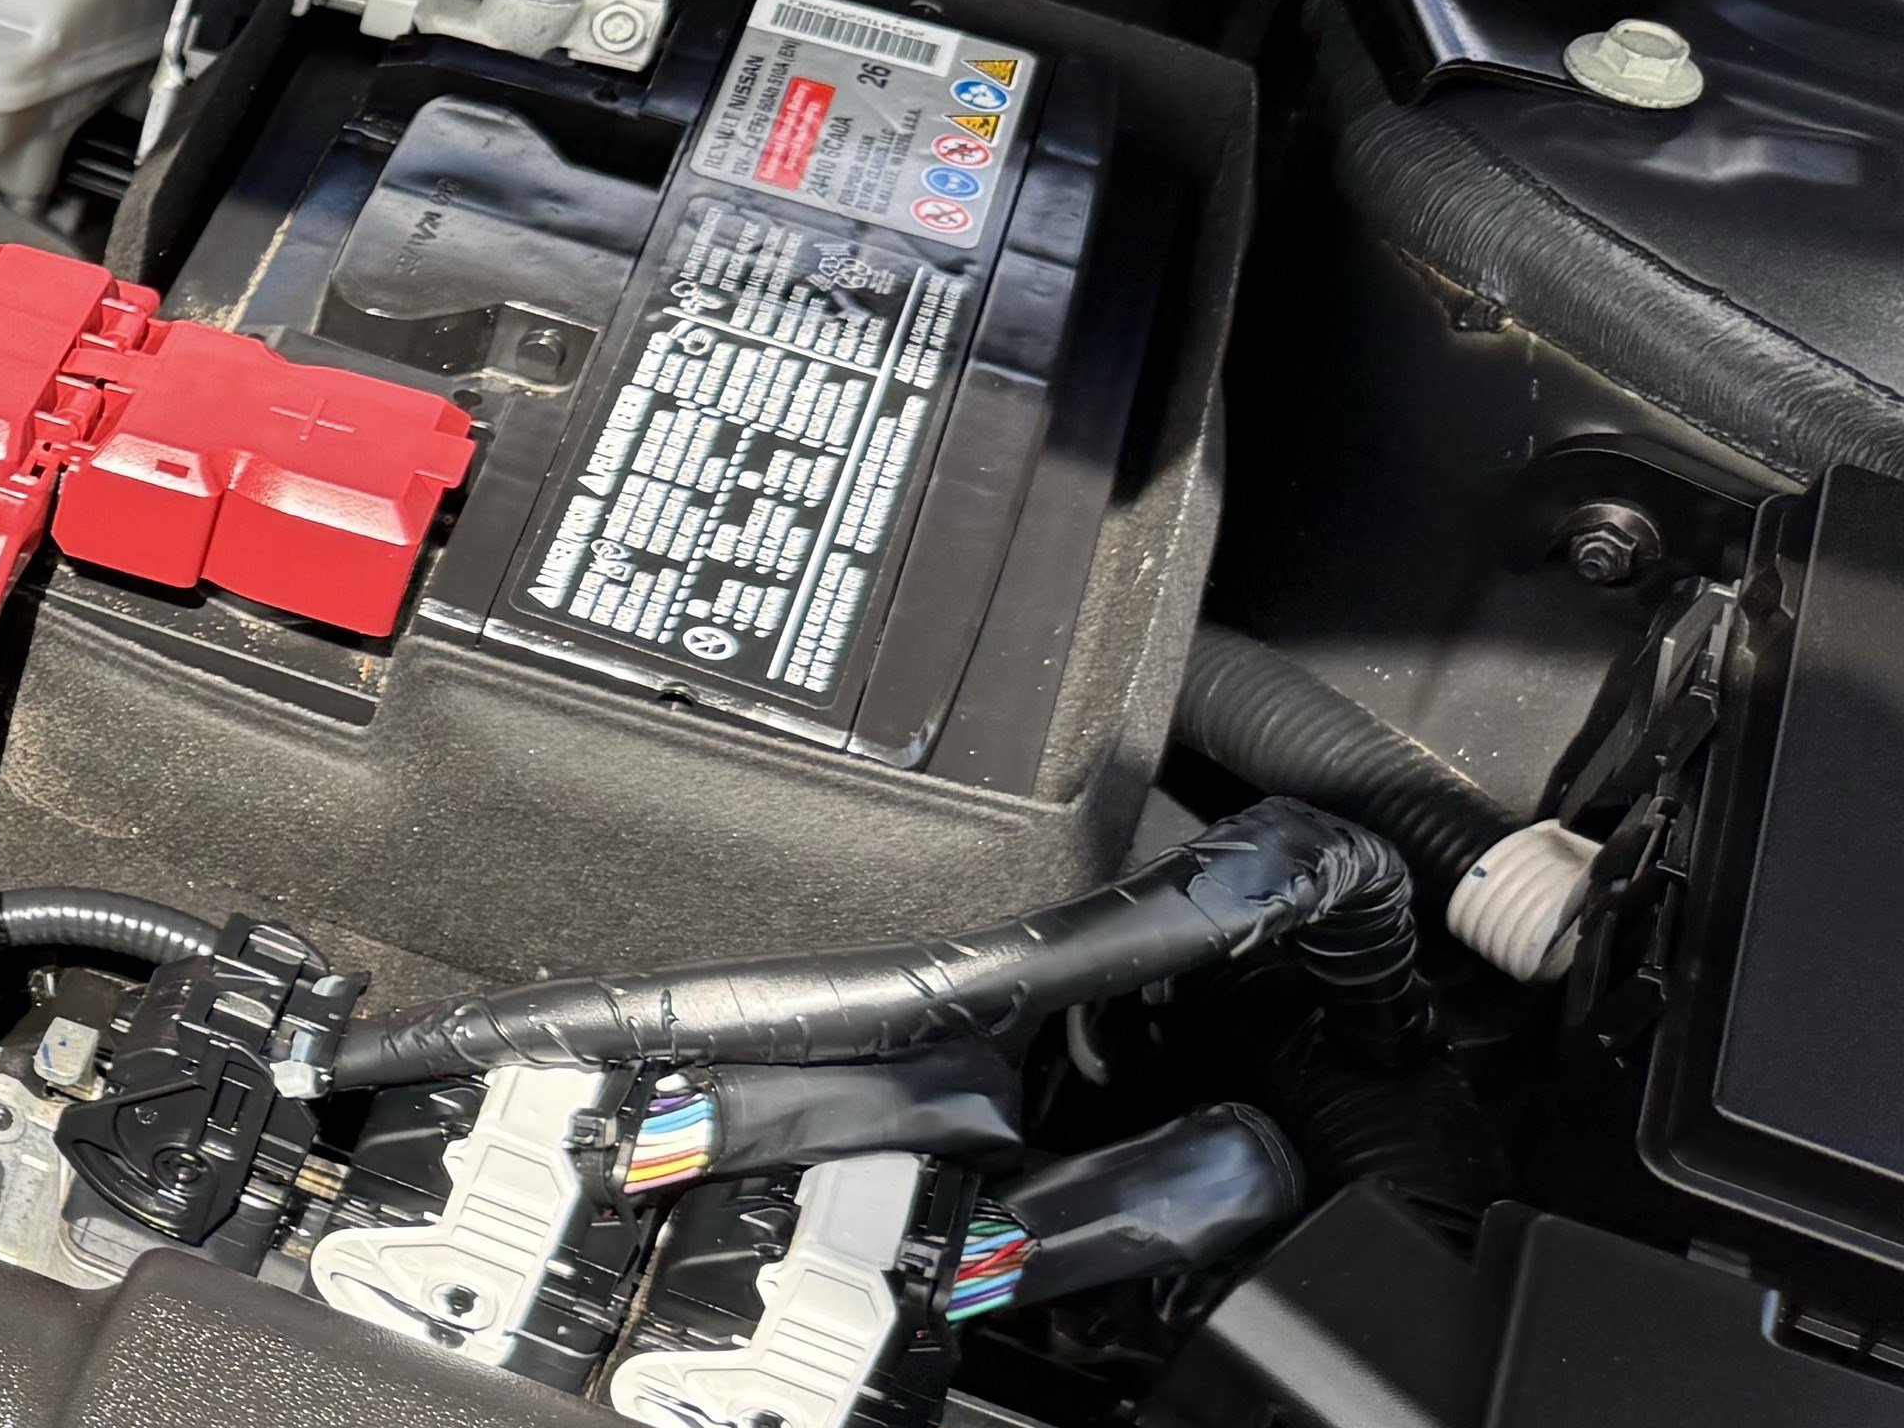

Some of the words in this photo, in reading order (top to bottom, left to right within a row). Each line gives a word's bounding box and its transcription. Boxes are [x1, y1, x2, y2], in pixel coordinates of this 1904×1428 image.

[725, 52, 766, 112] NISSAN
[854, 60, 893, 90] 26
[803, 157, 838, 199] 24410
